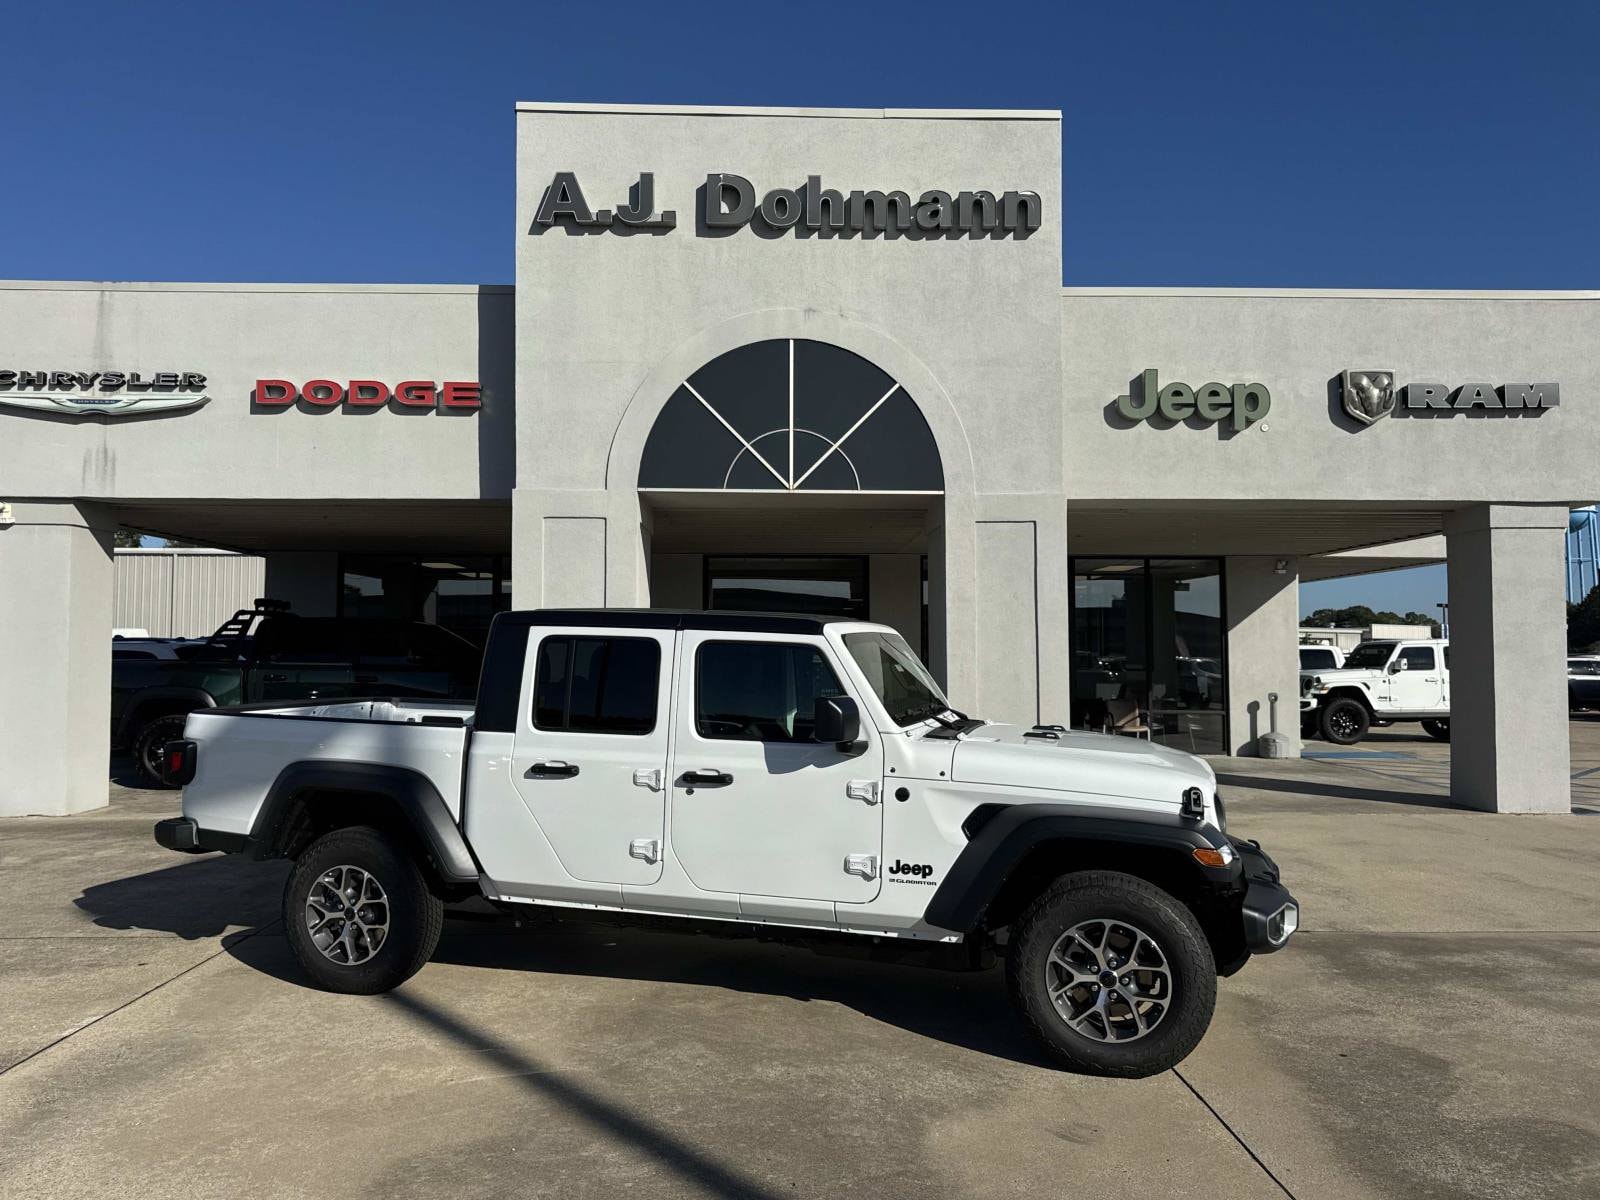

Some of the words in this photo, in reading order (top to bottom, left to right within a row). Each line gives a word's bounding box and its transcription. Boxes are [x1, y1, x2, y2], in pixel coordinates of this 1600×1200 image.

[536, 171, 676, 229] A.J.
[703, 172, 1042, 231] Dohmann
[255, 379, 482, 407] DODGE
[1117, 368, 1271, 431] Jeep
[1407, 382, 1560, 409] RAM
[889, 859, 933, 878] Jeep
